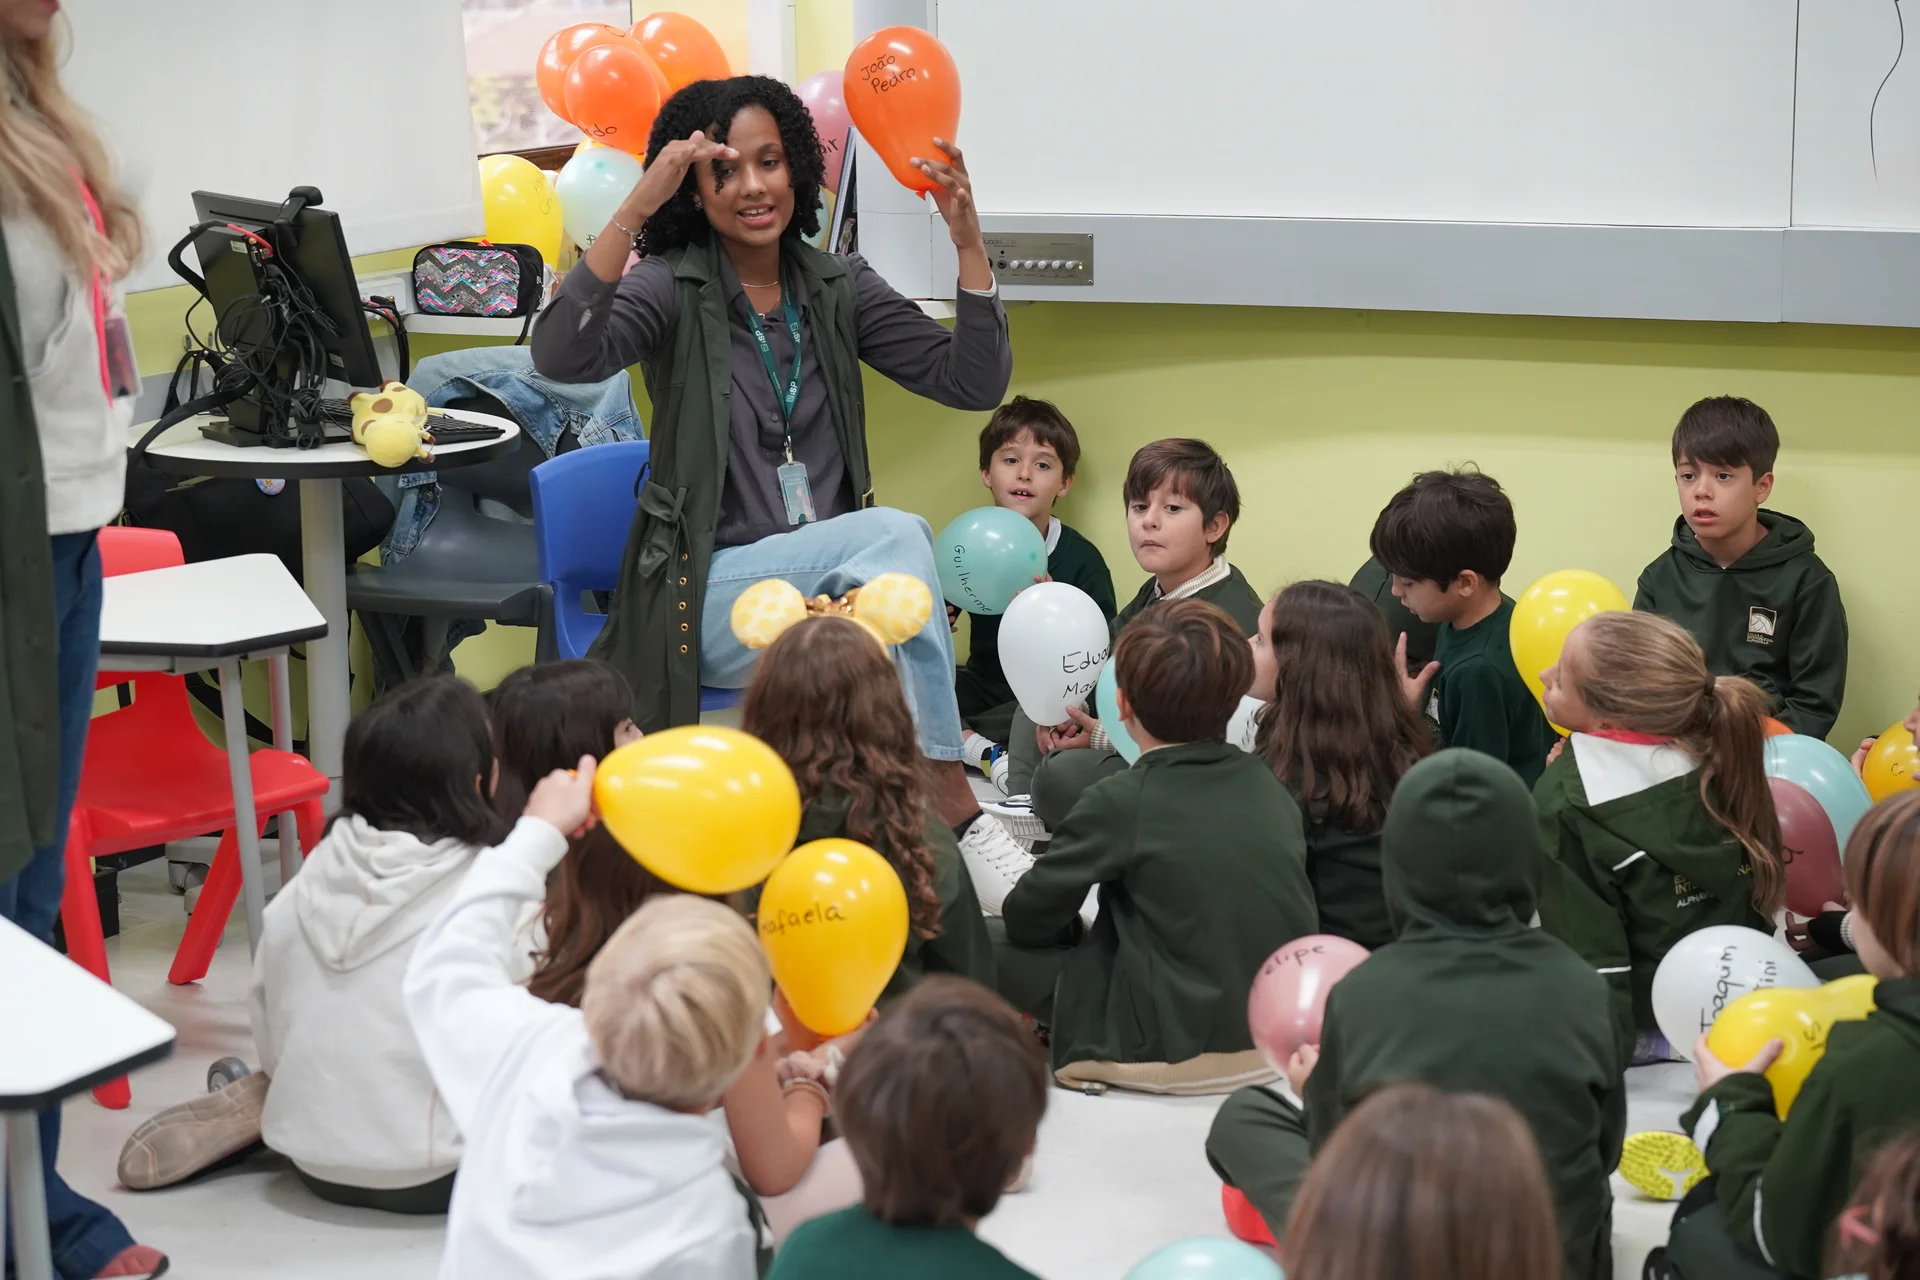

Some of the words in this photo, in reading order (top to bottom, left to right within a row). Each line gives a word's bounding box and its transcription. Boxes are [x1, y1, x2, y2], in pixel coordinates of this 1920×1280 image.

[860, 54, 896, 81] João
[871, 68, 916, 94] Pedro
[953, 544, 993, 613] Guilherme
[1259, 945, 1327, 982] elipe
